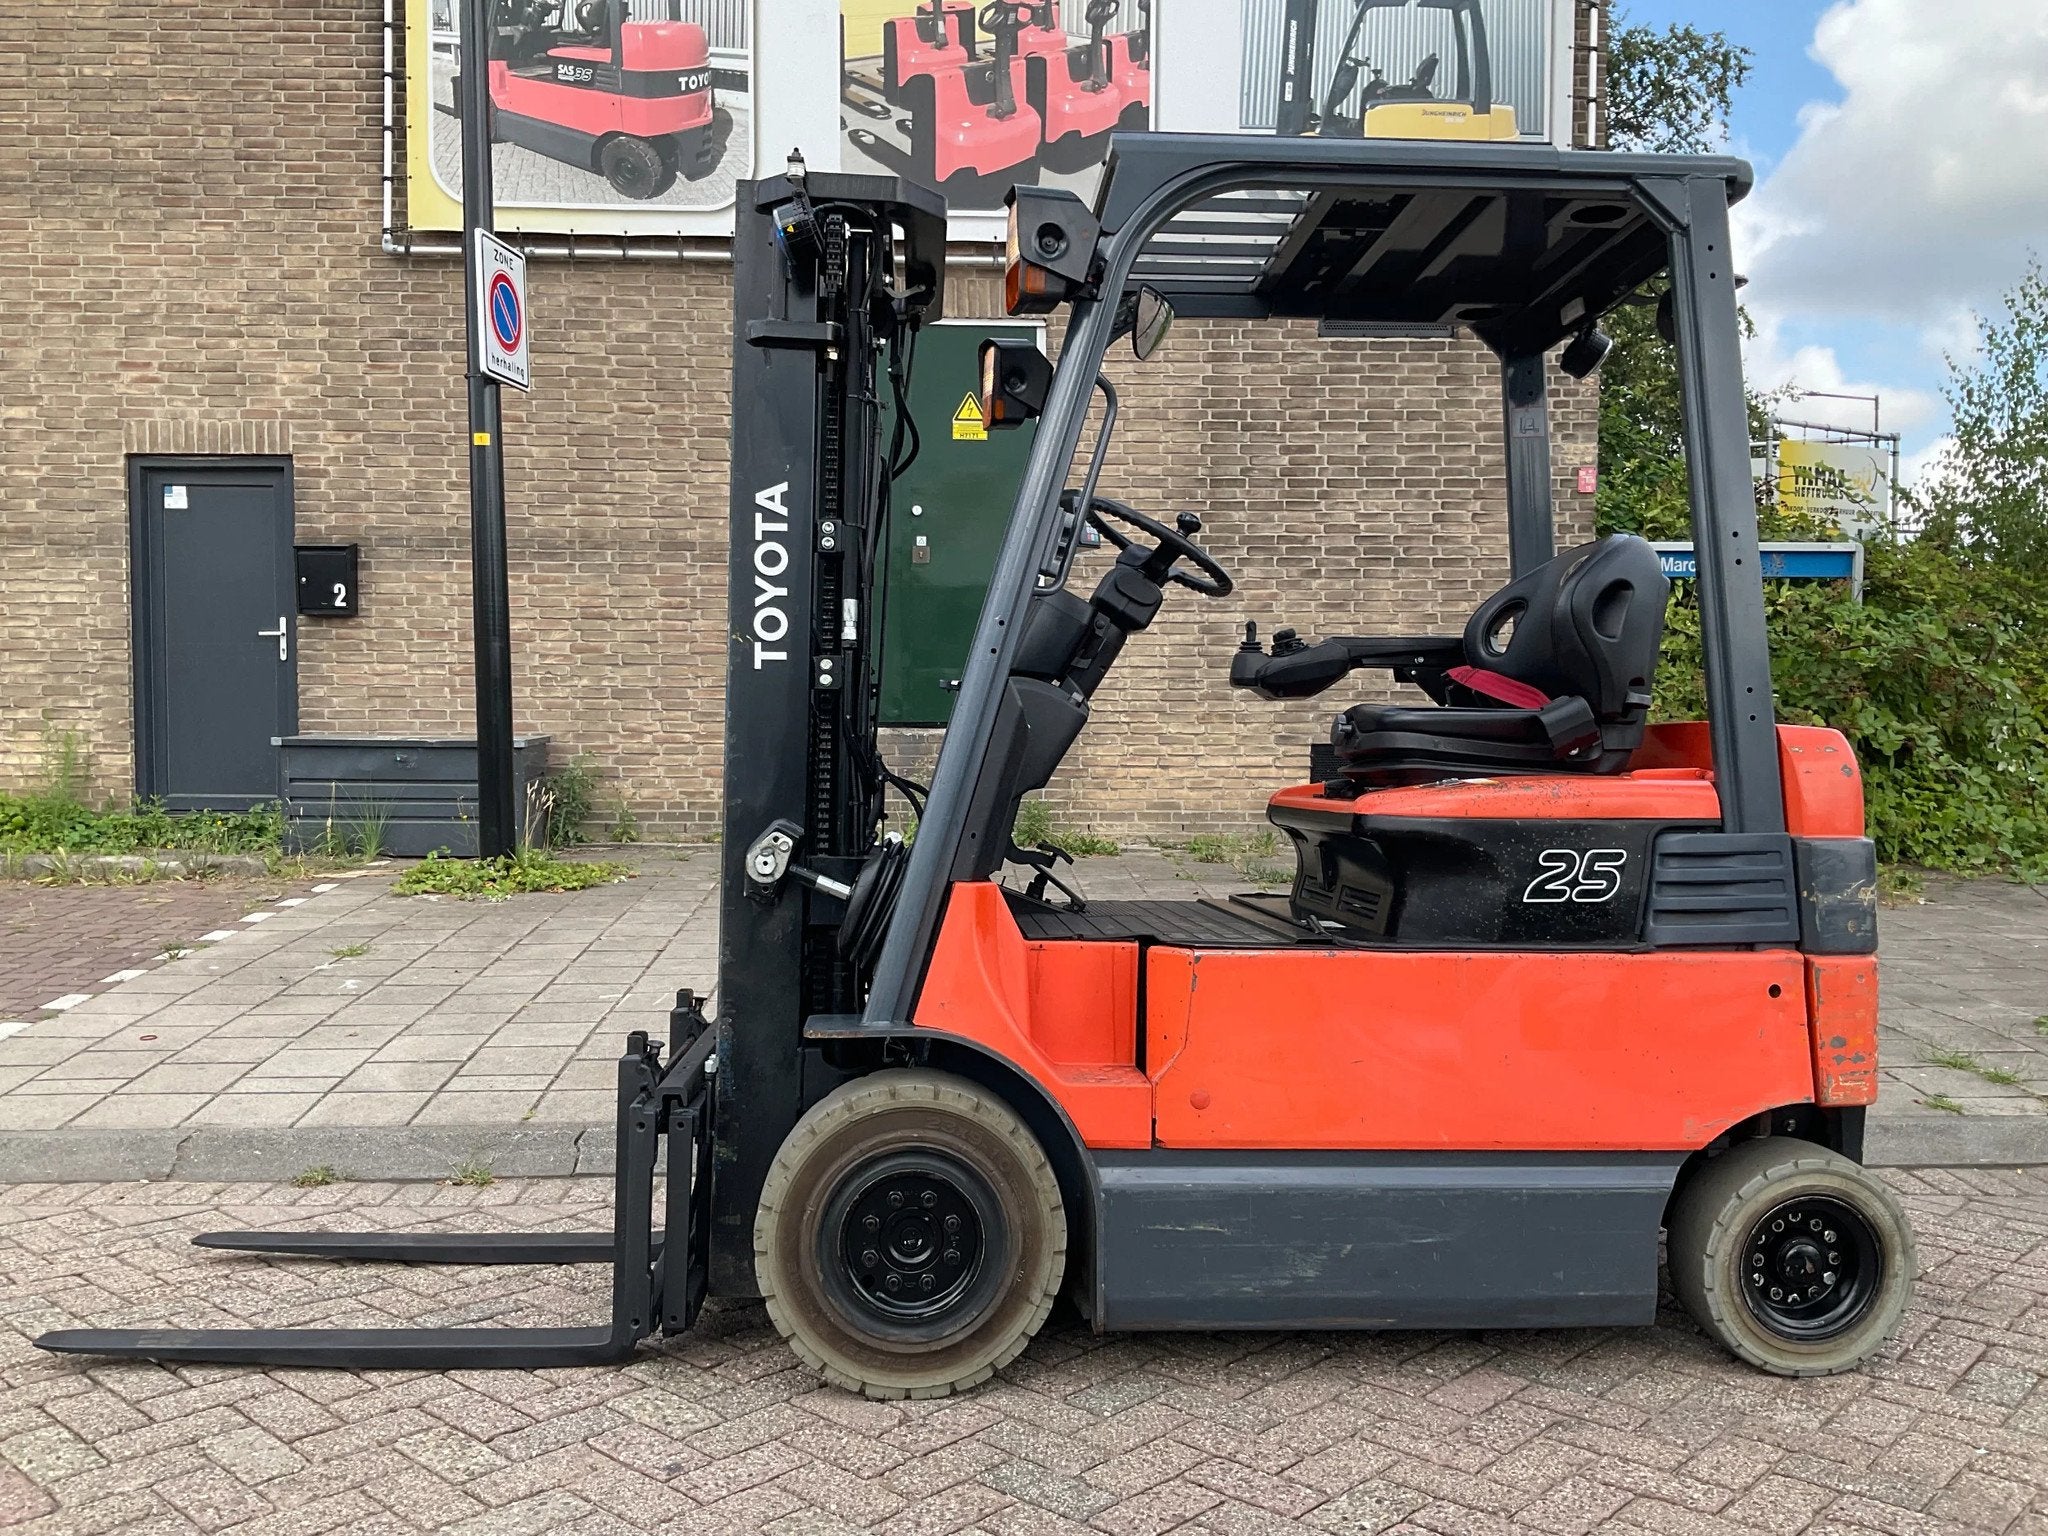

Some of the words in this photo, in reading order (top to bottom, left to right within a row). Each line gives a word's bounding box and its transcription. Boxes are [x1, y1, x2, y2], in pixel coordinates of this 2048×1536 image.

[557, 63, 575, 76] SAS
[574, 67, 593, 82] 35
[493, 248, 514, 271] ZONE
[491, 352, 525, 380] herhaling
[1795, 486, 1844, 500] HEFTRUS
[753, 481, 789, 670] TOYOTA
[334, 583, 347, 607] 2
[1523, 849, 1627, 902] 25
